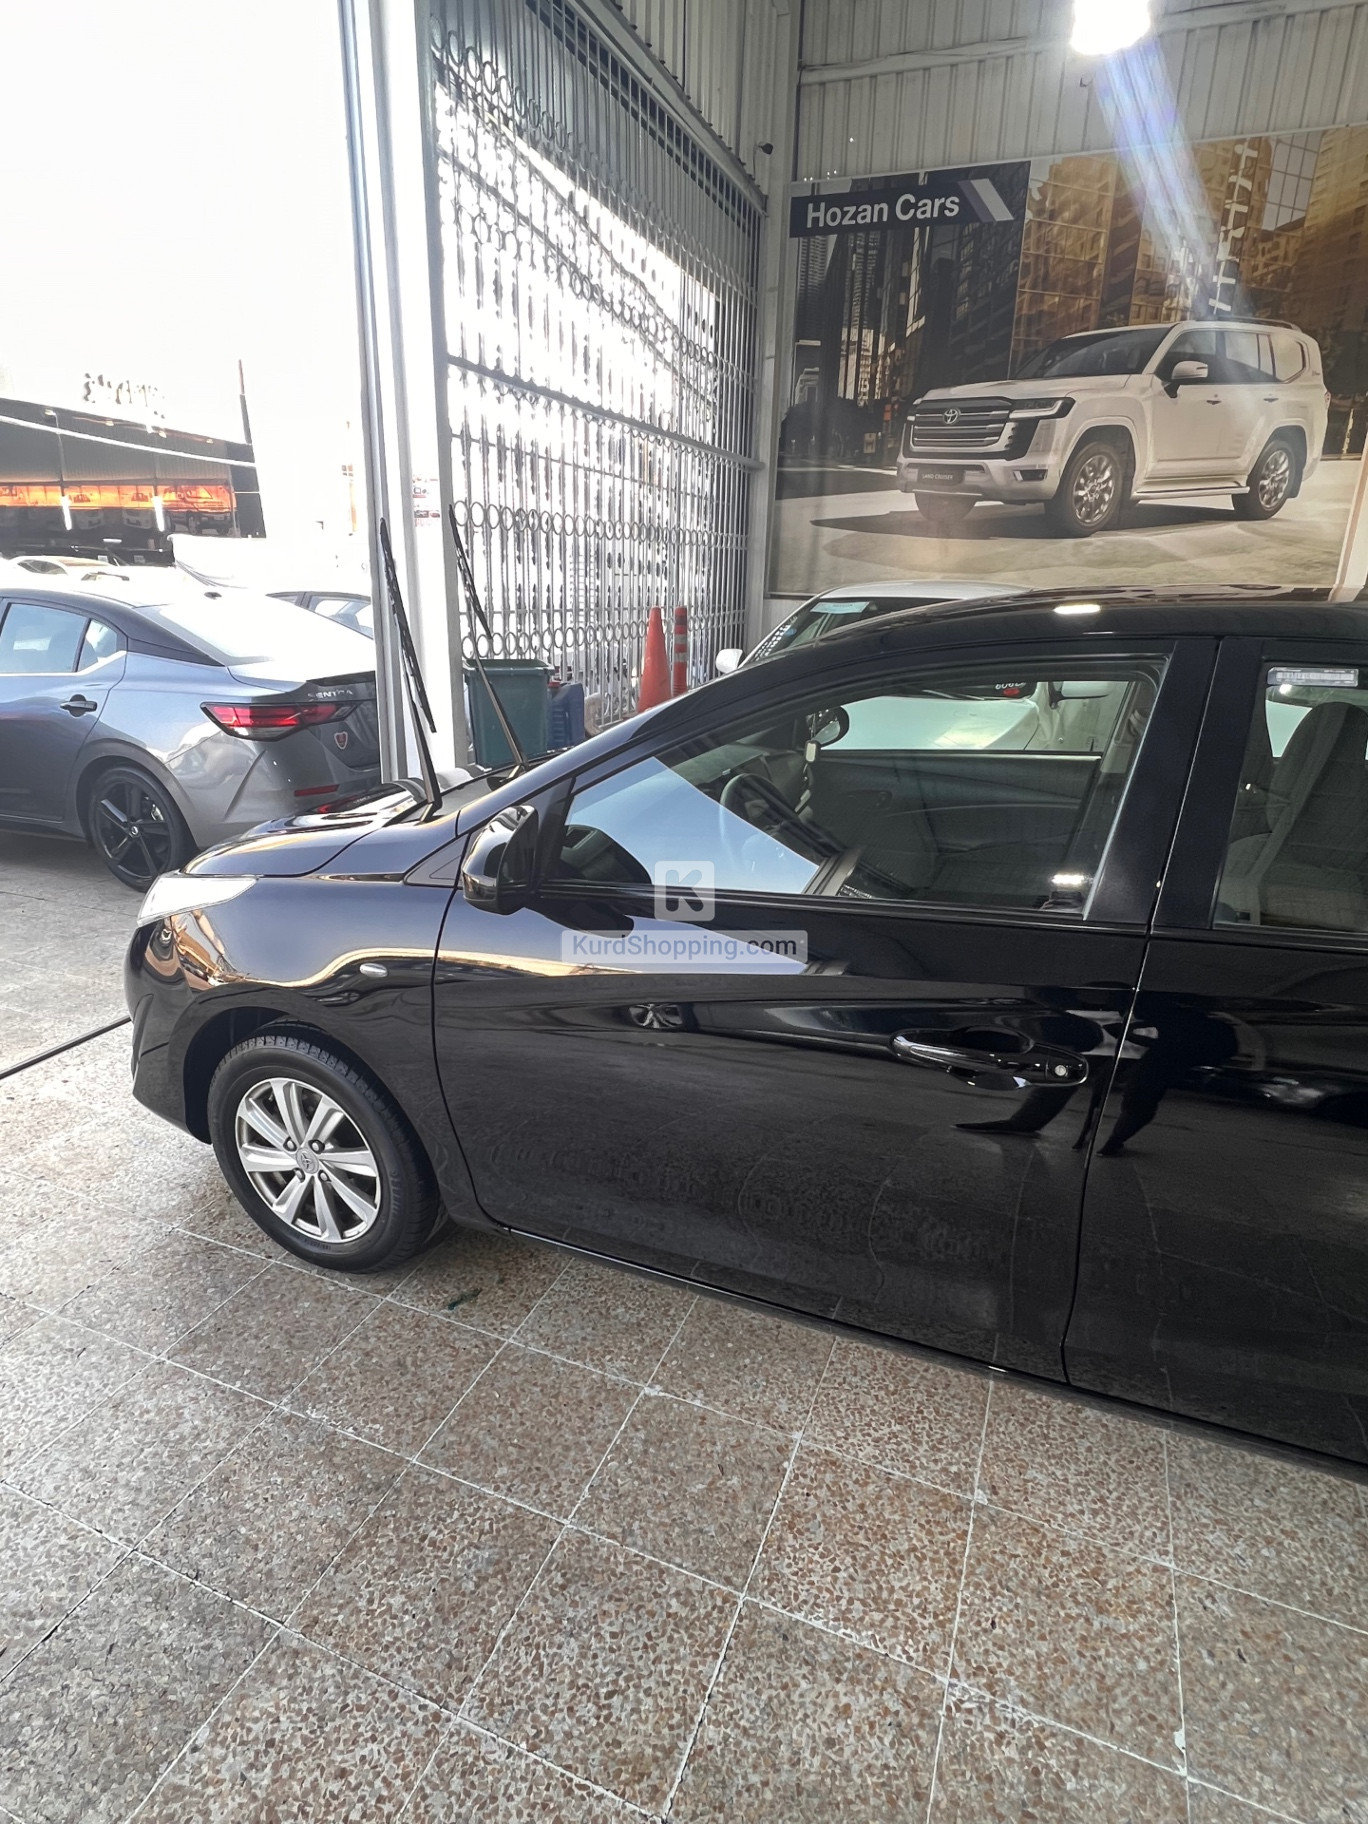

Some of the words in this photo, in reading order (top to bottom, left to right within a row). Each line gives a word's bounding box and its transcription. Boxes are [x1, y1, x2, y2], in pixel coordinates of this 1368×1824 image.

[806, 201, 889, 228] Hozan
[895, 193, 960, 221] Cars
[307, 689, 354, 702] SENTRA
